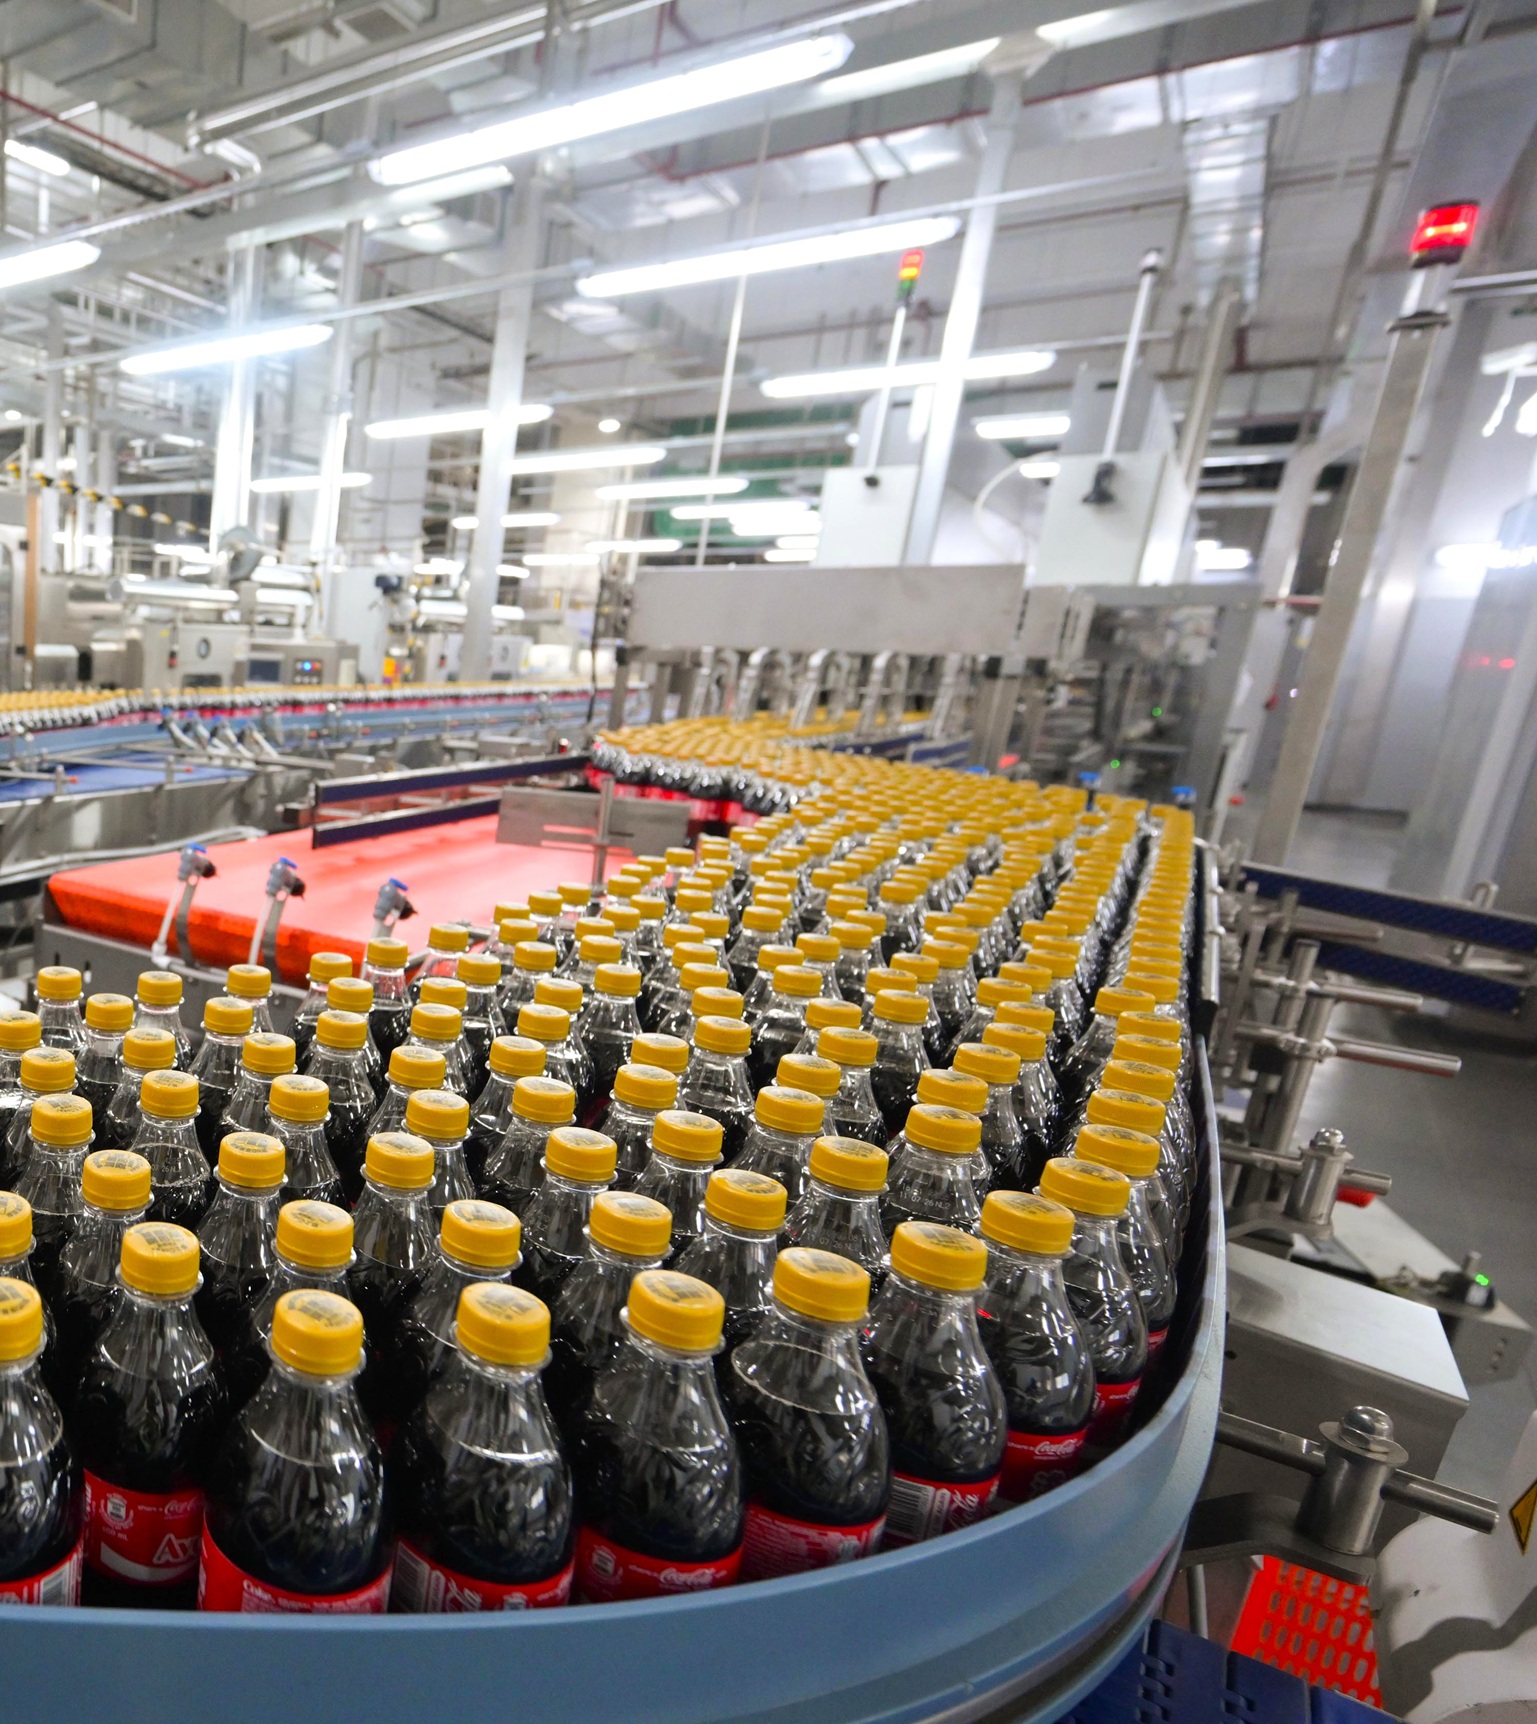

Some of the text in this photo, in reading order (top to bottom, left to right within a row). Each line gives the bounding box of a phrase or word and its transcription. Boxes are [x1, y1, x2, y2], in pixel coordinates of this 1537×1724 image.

[911, 1195, 922, 1203] 07
[1034, 1438, 1078, 1456] Coca-Cola
[659, 1567, 717, 1587] Coca-Cola
